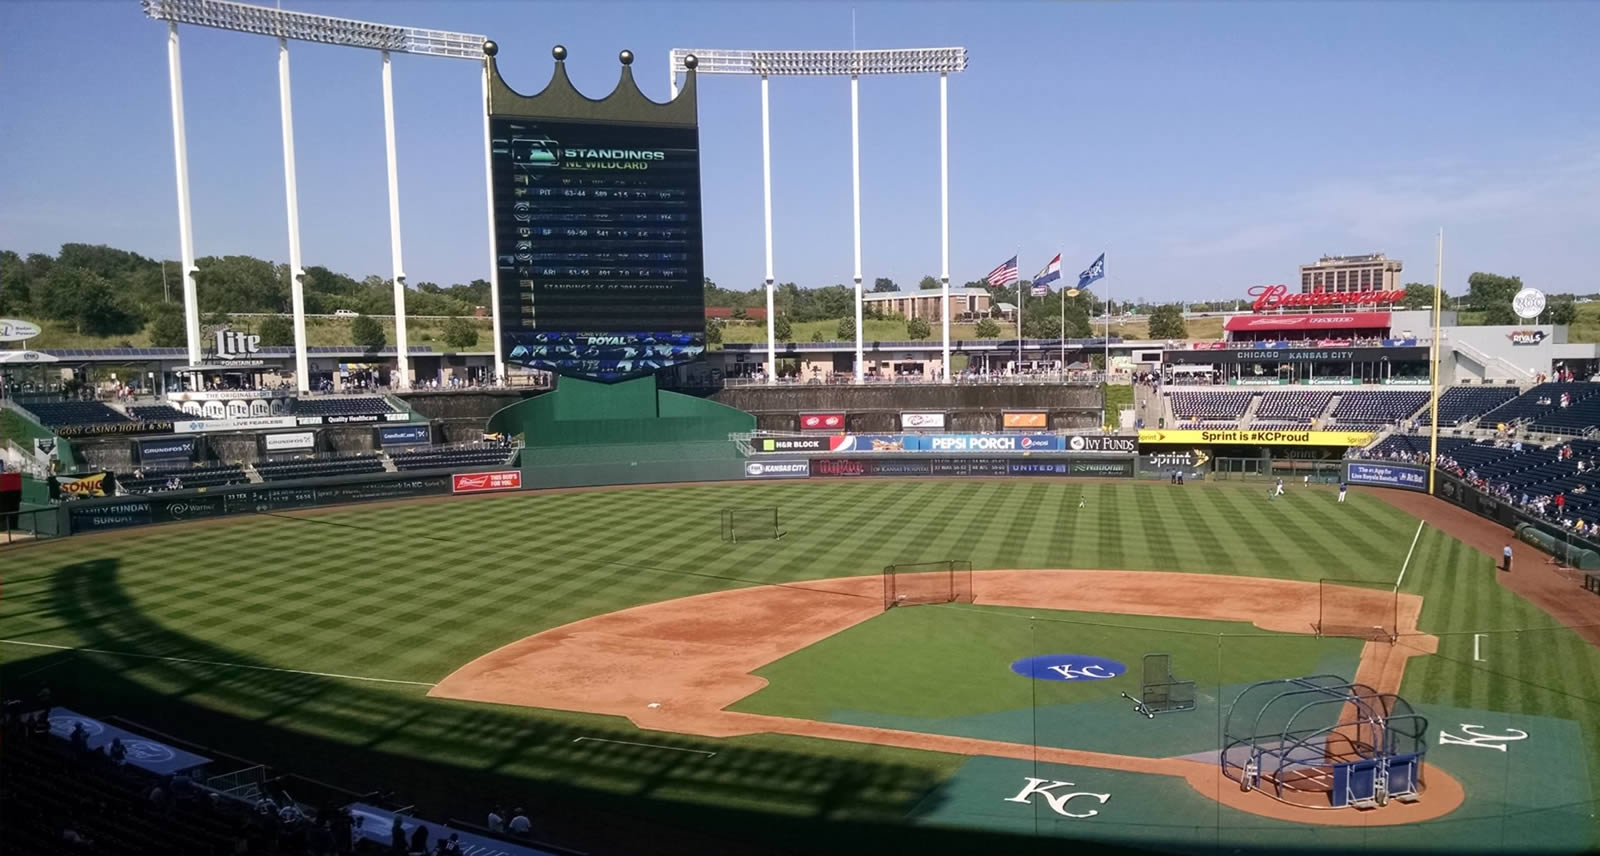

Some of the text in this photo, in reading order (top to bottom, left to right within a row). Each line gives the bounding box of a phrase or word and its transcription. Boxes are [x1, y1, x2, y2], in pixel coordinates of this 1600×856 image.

[564, 149, 665, 161] STANDINGS
[585, 162, 649, 170] WILDCARD
[1248, 283, 1407, 313] Budweiser
[587, 336, 627, 345] ROYAL
[1513, 334, 1541, 342] RIVALS
[216, 328, 260, 360] Lite
[1289, 351, 1328, 359] KANSAS
[1331, 351, 1353, 359] CITY
[327, 416, 348, 424] Quality
[349, 414, 377, 422] Healthcare
[84, 425, 116, 435] CASINO
[119, 423, 146, 432] HOTEL
[157, 422, 172, 430] SPA
[1202, 431, 1309, 443] Sprint is #KCProud
[775, 440, 820, 448] H&R BLOCK
[932, 437, 1016, 449] PEPSI PORCH
[1085, 437, 1134, 450] IVY FUNDS
[143, 446, 182, 454] GRUNDFOS
[765, 464, 792, 472] KANSAS
[792, 463, 808, 471] CITY
[1012, 464, 1054, 472] UNITED
[1086, 463, 1124, 471] National
[1362, 473, 1379, 481] Royals
[62, 480, 102, 493] SONIC
[111, 503, 149, 513] FUNDAY
[1048, 662, 1116, 680] KC
[1004, 776, 1112, 818] KC
